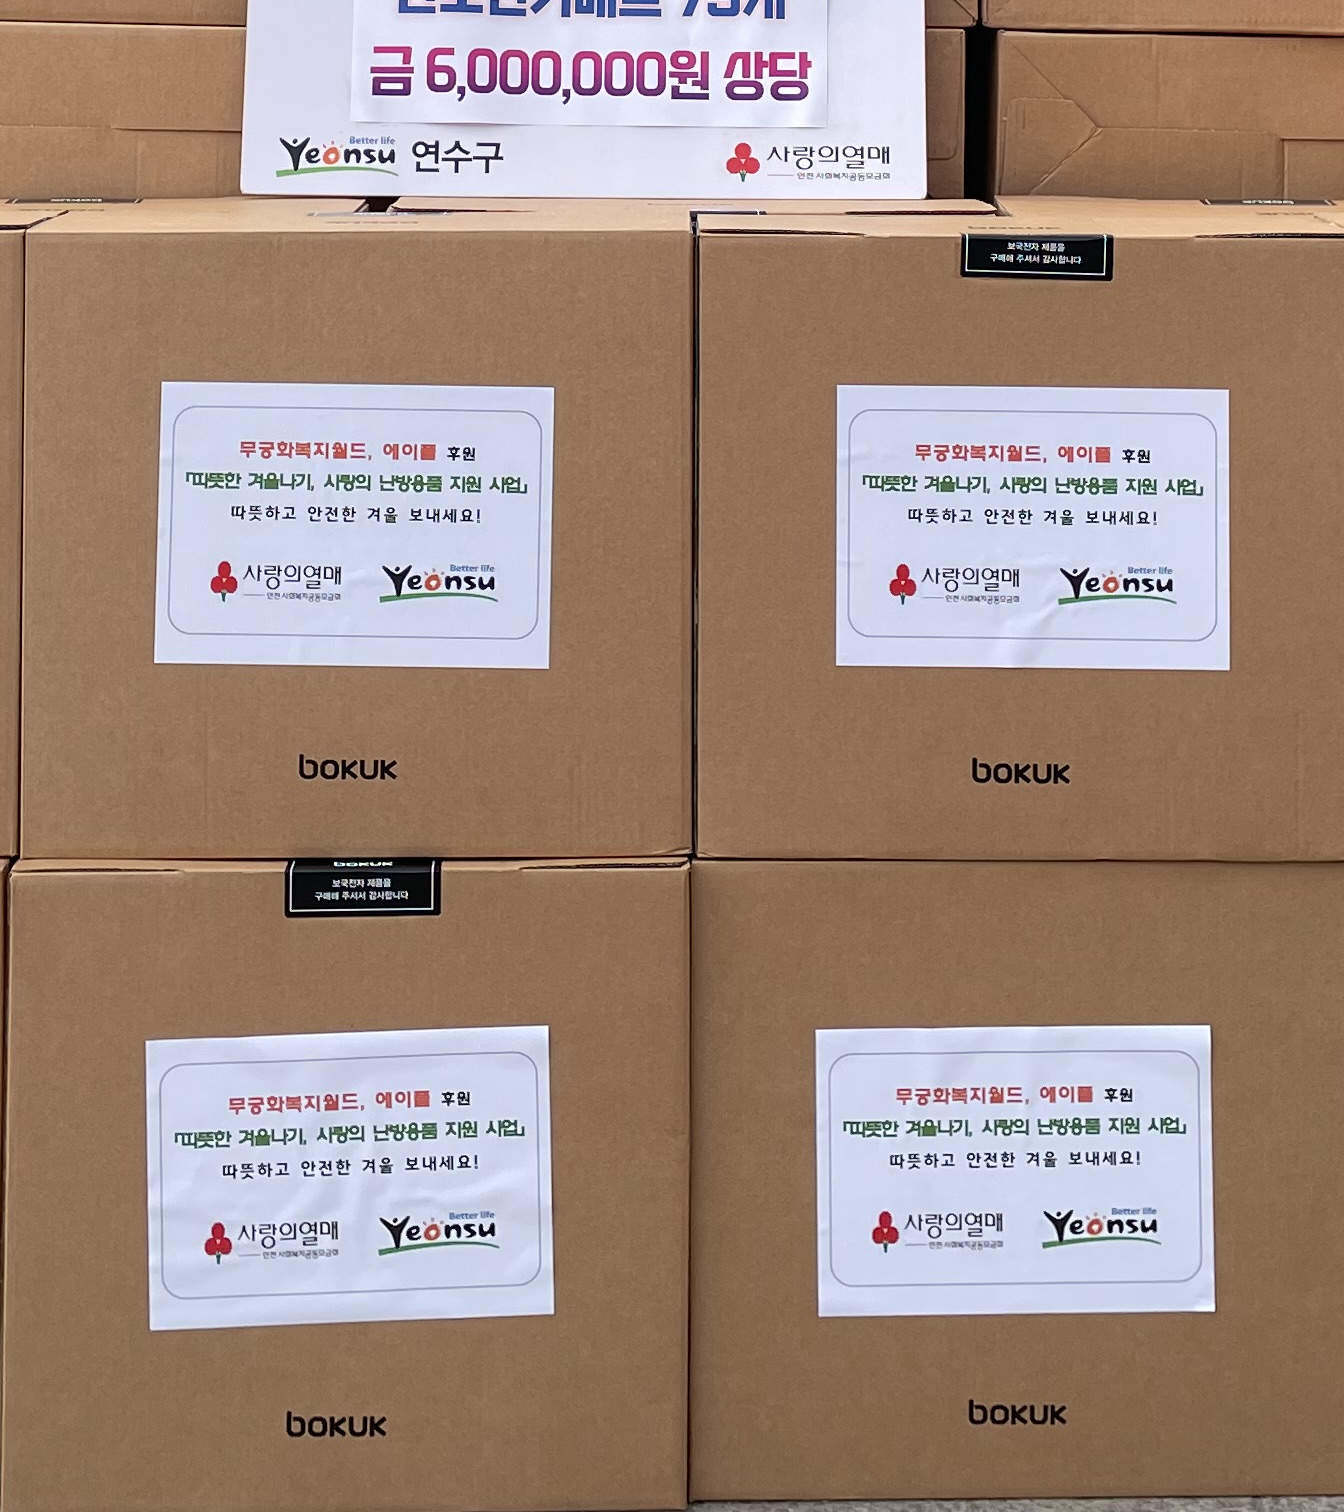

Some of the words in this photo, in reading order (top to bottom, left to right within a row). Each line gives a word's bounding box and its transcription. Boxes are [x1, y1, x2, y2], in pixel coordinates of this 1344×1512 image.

[369, 45, 415, 96] 금
[425, 47, 710, 105] 6,000,000원
[723, 50, 813, 102] 상당
[348, 135, 378, 146] Better
[380, 135, 396, 146] life
[279, 137, 396, 172] Yeonsu
[411, 140, 504, 174] 연수구
[766, 145, 891, 170] 사랑의열매
[240, 441, 372, 461] 무궁화복지월드,
[447, 446, 475, 461] 후원
[915, 444, 1046, 463] 무궁화복지월드,
[1122, 449, 1150, 463] 후원
[248, 472, 314, 491] 겨울나기,
[324, 474, 371, 491] 사랑의
[380, 475, 442, 493] 난방용품
[450, 476, 481, 493] 지원
[924, 475, 990, 494] 겨울나기,
[1000, 477, 1047, 494] 사랑의
[1055, 477, 1118, 495] 난방용품
[1126, 478, 1157, 495] 지원
[231, 505, 296, 521] 따뜻하고
[308, 506, 356, 522] 안전한
[367, 507, 398, 523] 겨울
[409, 508, 480, 523] 보내세요!
[908, 508, 973, 524] 따뜻하고
[984, 509, 1033, 525] 안전한
[1043, 509, 1074, 525] 겨울
[1085, 511, 1157, 525] 보내세요!
[243, 565, 341, 590] 사랑의열매
[384, 564, 494, 600] Yeonsu
[921, 568, 1019, 592] 사랑의열매
[1060, 567, 1173, 602] Yeonsu
[229, 1093, 364, 1115] 무궁화복지월드,
[441, 1091, 470, 1107] 후원
[896, 1086, 1029, 1106] 무궁화복지월드,
[1104, 1088, 1133, 1102] 후원
[239, 1128, 307, 1147] 겨울나기,
[316, 1125, 365, 1144] 사랑의
[373, 1122, 438, 1142] 난방용품
[446, 1121, 478, 1139] 지원
[222, 1162, 290, 1180] 따뜻하고
[301, 1159, 351, 1177] 안전한
[362, 1157, 393, 1174] 겨울
[405, 1155, 478, 1171] 보내세요!
[890, 1153, 955, 1170] 따뜻하고
[967, 1151, 1015, 1168] 안전한
[1026, 1151, 1057, 1167] 겨울
[1068, 1151, 1140, 1166] 보내세요!
[238, 1221, 338, 1249] 사랑의열매
[381, 1211, 496, 1249] Yeonsu
[904, 1213, 1003, 1239] 사랑의열매
[1045, 1207, 1158, 1245] Yeonsu
